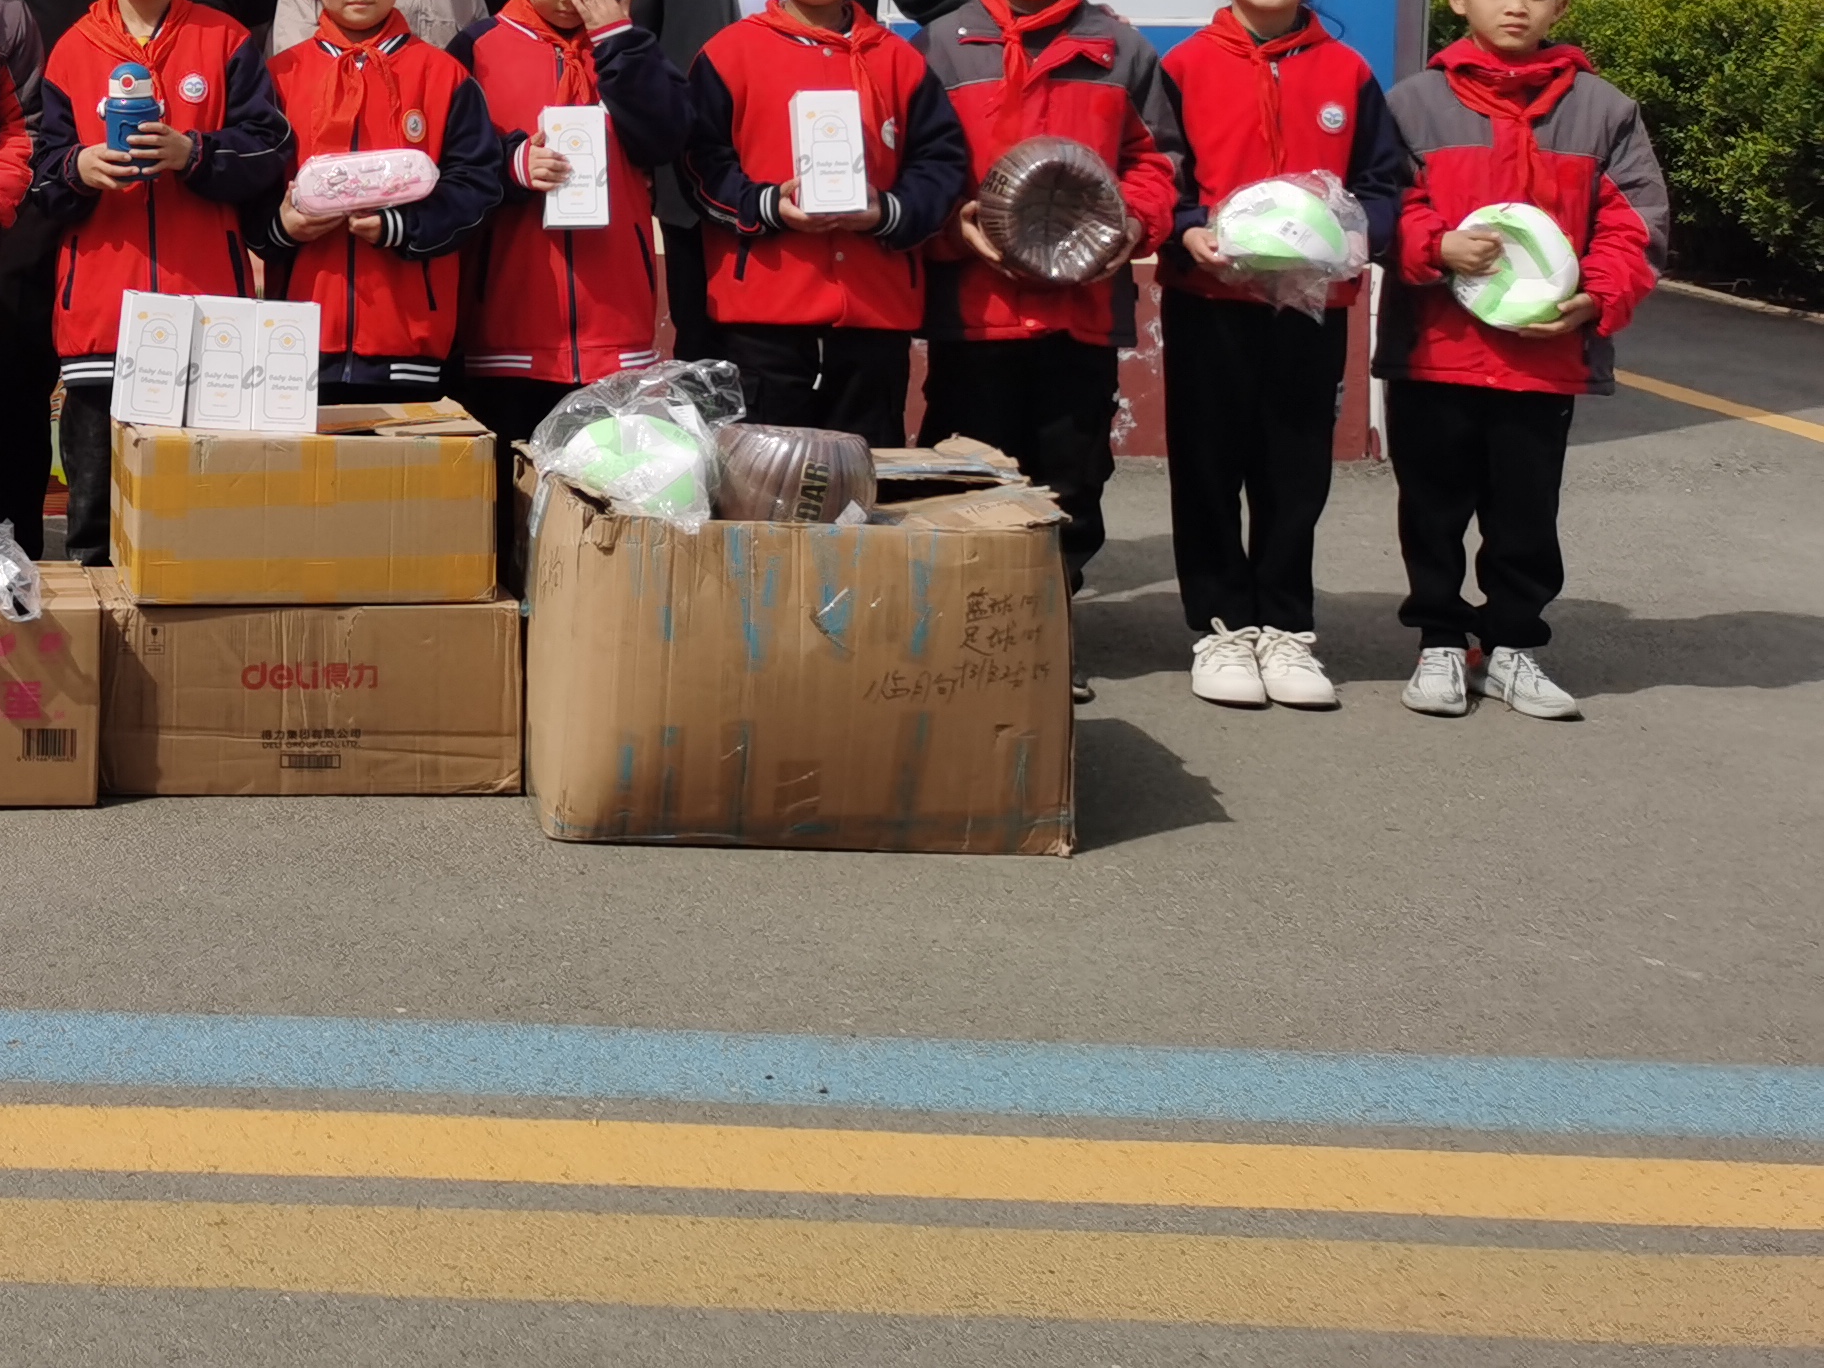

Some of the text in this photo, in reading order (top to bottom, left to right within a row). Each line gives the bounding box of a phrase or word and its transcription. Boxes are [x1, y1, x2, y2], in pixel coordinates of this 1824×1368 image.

[261, 728, 362, 740] 得力集团有限公司
